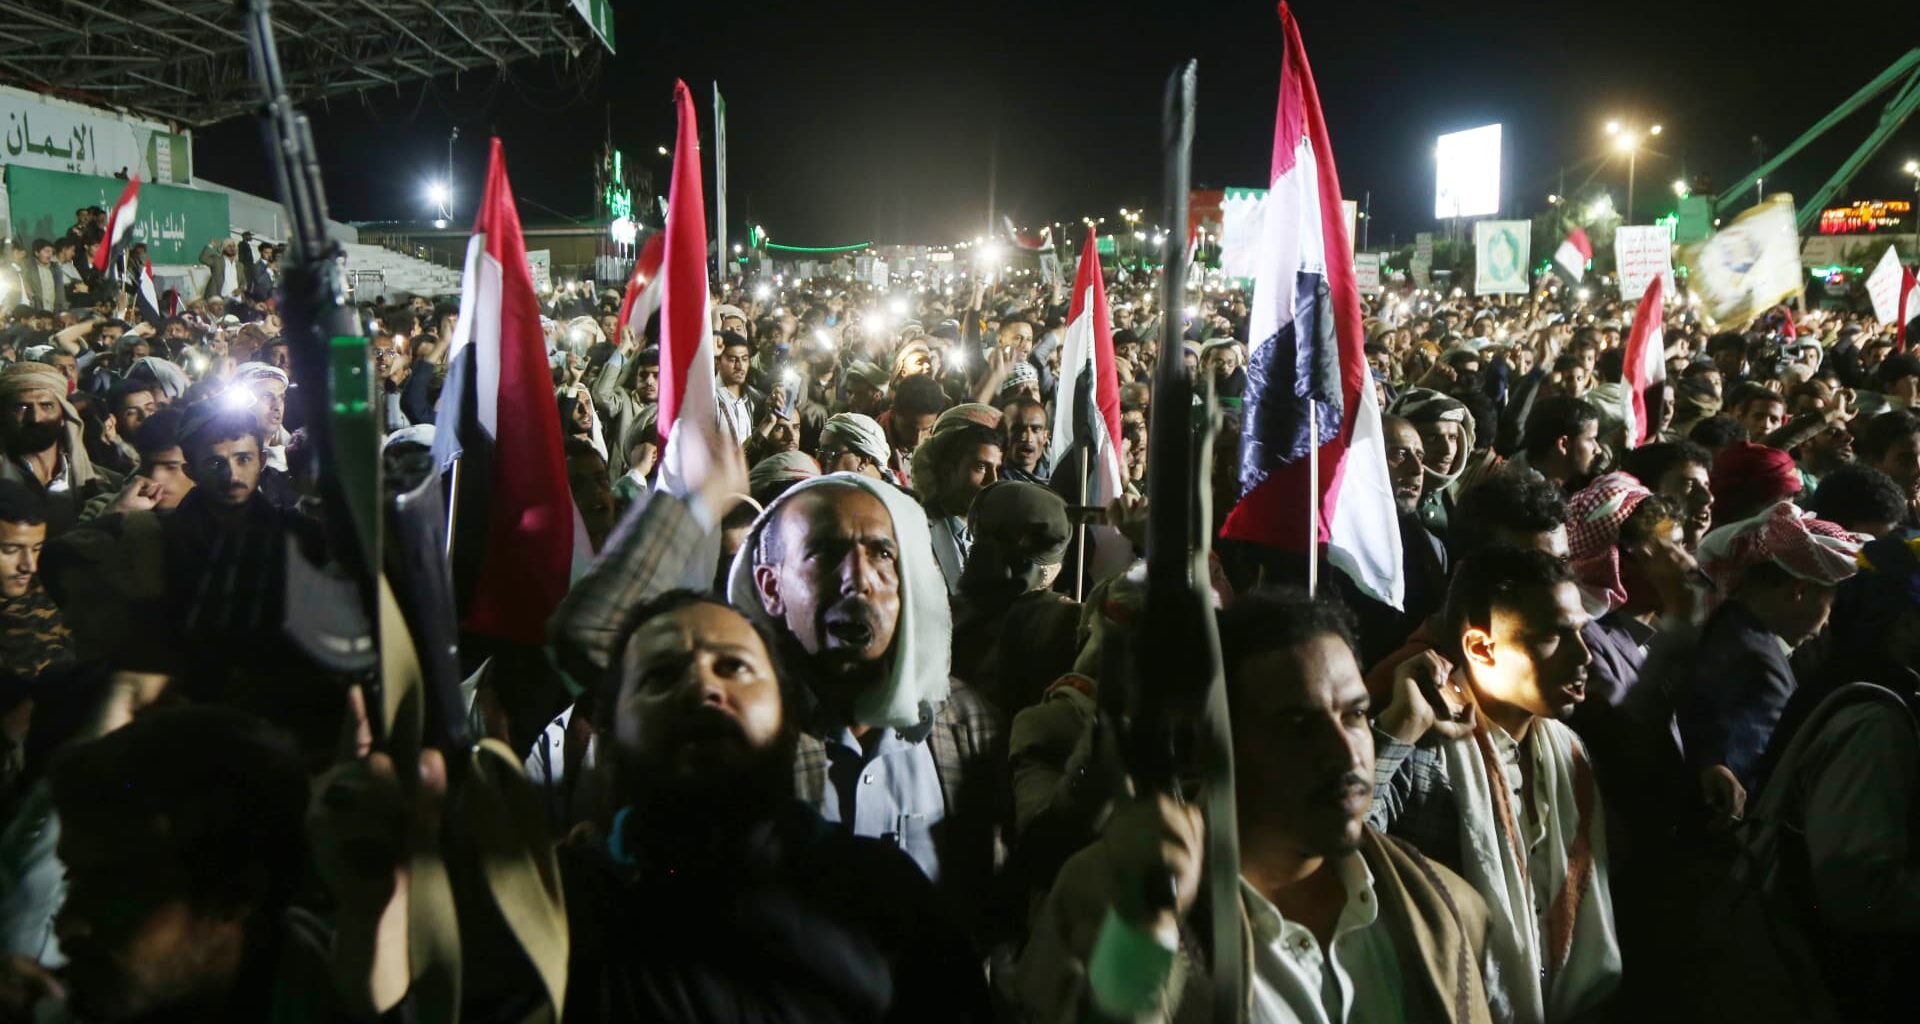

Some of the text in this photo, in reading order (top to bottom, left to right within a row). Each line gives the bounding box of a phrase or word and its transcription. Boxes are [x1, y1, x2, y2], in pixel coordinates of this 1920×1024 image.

[7, 109, 96, 172] الإيمان
[150, 211, 160, 247] يا
[161, 212, 185, 252] لبيك
